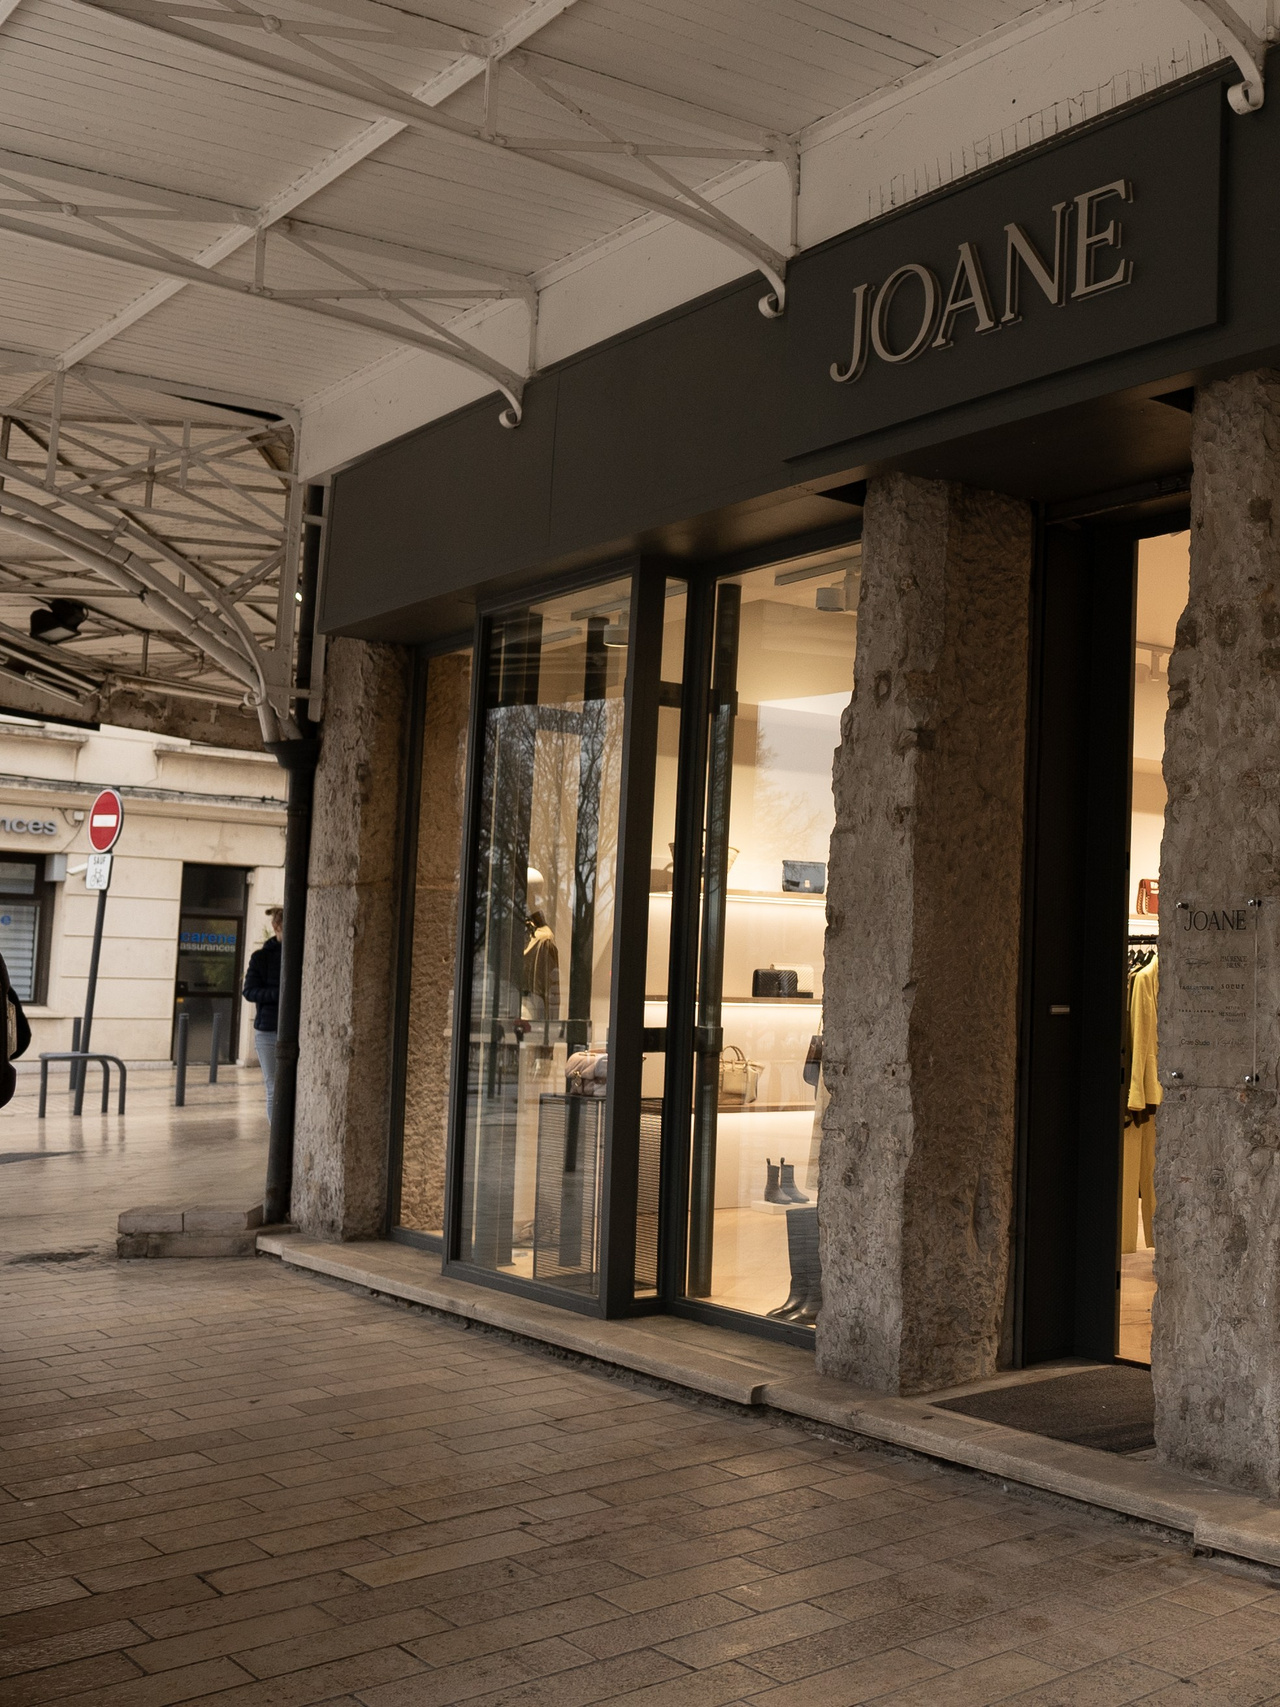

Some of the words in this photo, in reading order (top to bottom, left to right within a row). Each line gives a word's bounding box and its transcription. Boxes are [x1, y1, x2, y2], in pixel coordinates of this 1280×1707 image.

[829, 178, 1134, 385] JOANE
[93, 856, 107, 866] SAUF
[1183, 910, 1247, 931] JOANE
[180, 943, 236, 952] assurances
